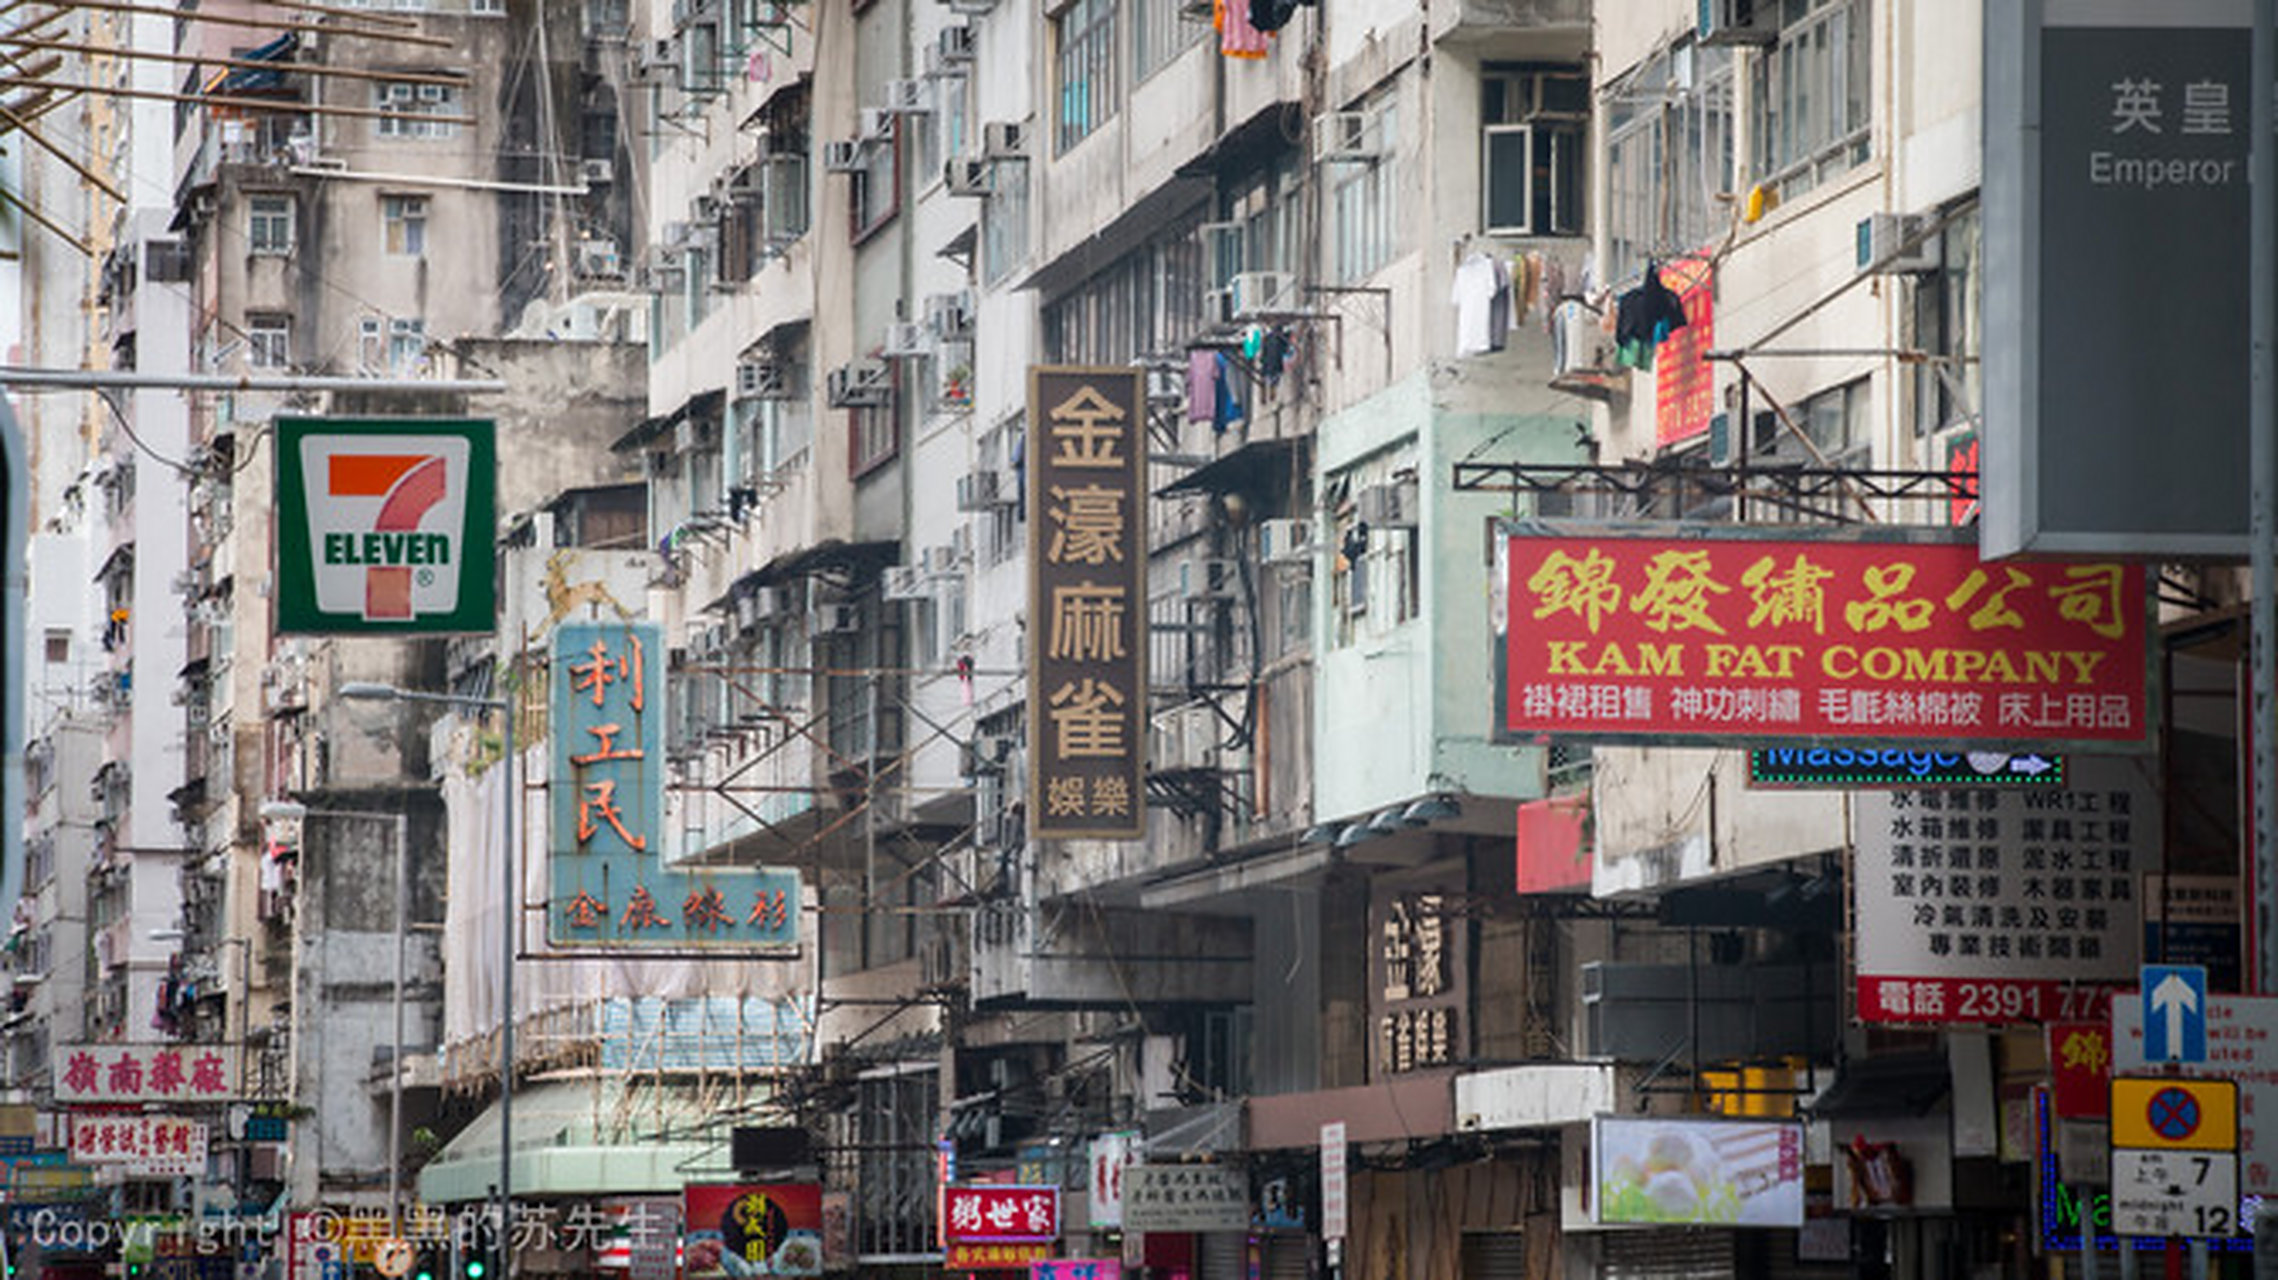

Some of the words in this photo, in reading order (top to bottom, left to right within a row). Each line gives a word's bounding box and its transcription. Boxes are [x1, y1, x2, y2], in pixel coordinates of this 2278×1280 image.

[2111, 77, 2232, 134] 英皇
[2090, 151, 2234, 189] Emperor
[1048, 384, 1127, 760] 金濠麻雀
[1527, 547, 2126, 640] 錦發繡品公司
[1546, 642, 1685, 677] KAM
[1706, 644, 1804, 679] FAT
[1821, 646, 2108, 684] COMPANY
[1997, 692, 2131, 729] 床上用品
[569, 634, 646, 852] 利工民
[1877, 981, 1946, 1017] 電話
[1958, 984, 2042, 1018] 2391
[2191, 1157, 2211, 1186] 7
[2194, 1205, 2230, 1234] 12
